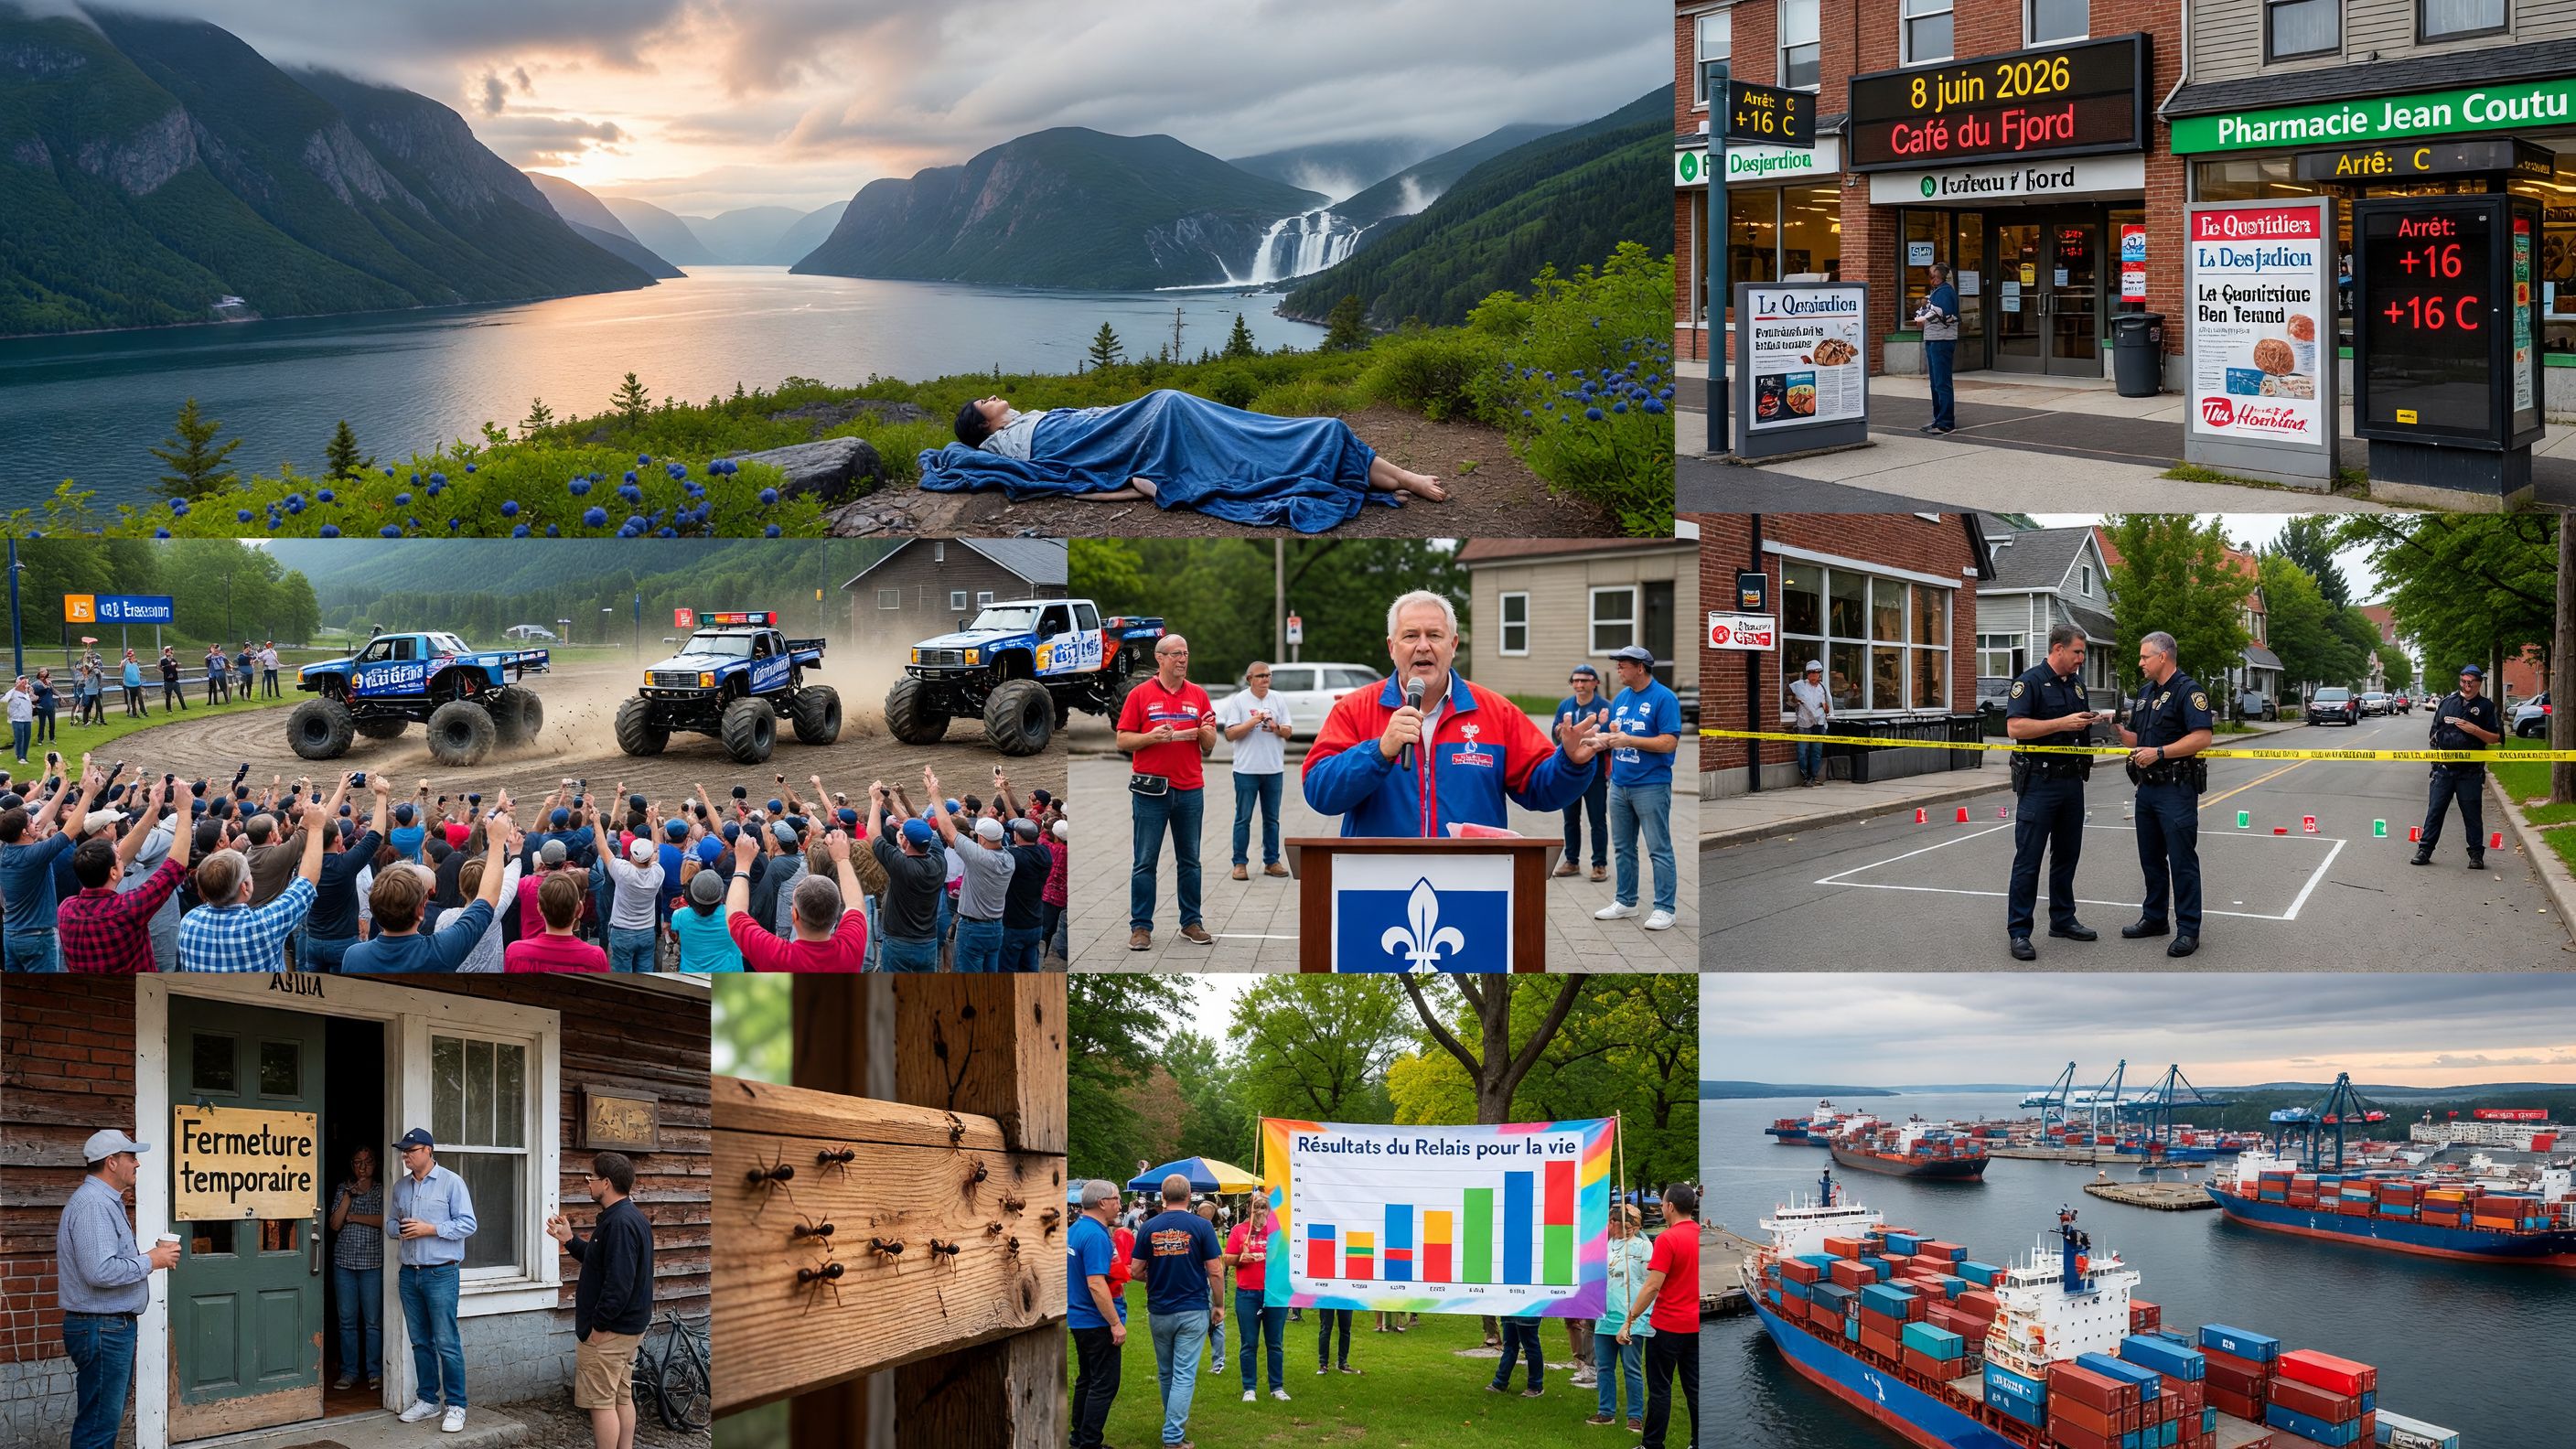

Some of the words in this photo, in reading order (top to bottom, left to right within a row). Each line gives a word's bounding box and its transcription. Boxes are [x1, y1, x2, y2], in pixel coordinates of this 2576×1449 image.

[1911, 78, 1927, 109] 8
[1935, 70, 1984, 113] juin
[1996, 56, 2070, 99] 2026
[1736, 110, 1774, 134] +16
[1783, 115, 1795, 136] C
[1892, 118, 1948, 155] Café
[1958, 114, 1990, 148] du
[2002, 102, 2074, 151] Fjord
[2218, 106, 2367, 145] Pharmacie
[2377, 101, 2452, 132] Jean
[2463, 90, 2568, 123] Coutu
[2413, 147, 2431, 171] C
[2398, 218, 2456, 238] Arrêt:
[2399, 243, 2462, 278] +16
[2384, 295, 2445, 329] +16
[2456, 295, 2478, 330] C
[183, 1119, 312, 1157] Fermeture
[1298, 1135, 1381, 1155] Résultats
[1386, 1137, 1409, 1155] du
[1415, 1138, 1470, 1155] Relais
[1476, 1141, 1518, 1160] pour
[1526, 1137, 1542, 1154] la
[1548, 1137, 1576, 1154] vie
[180, 1161, 311, 1204] temporaire
